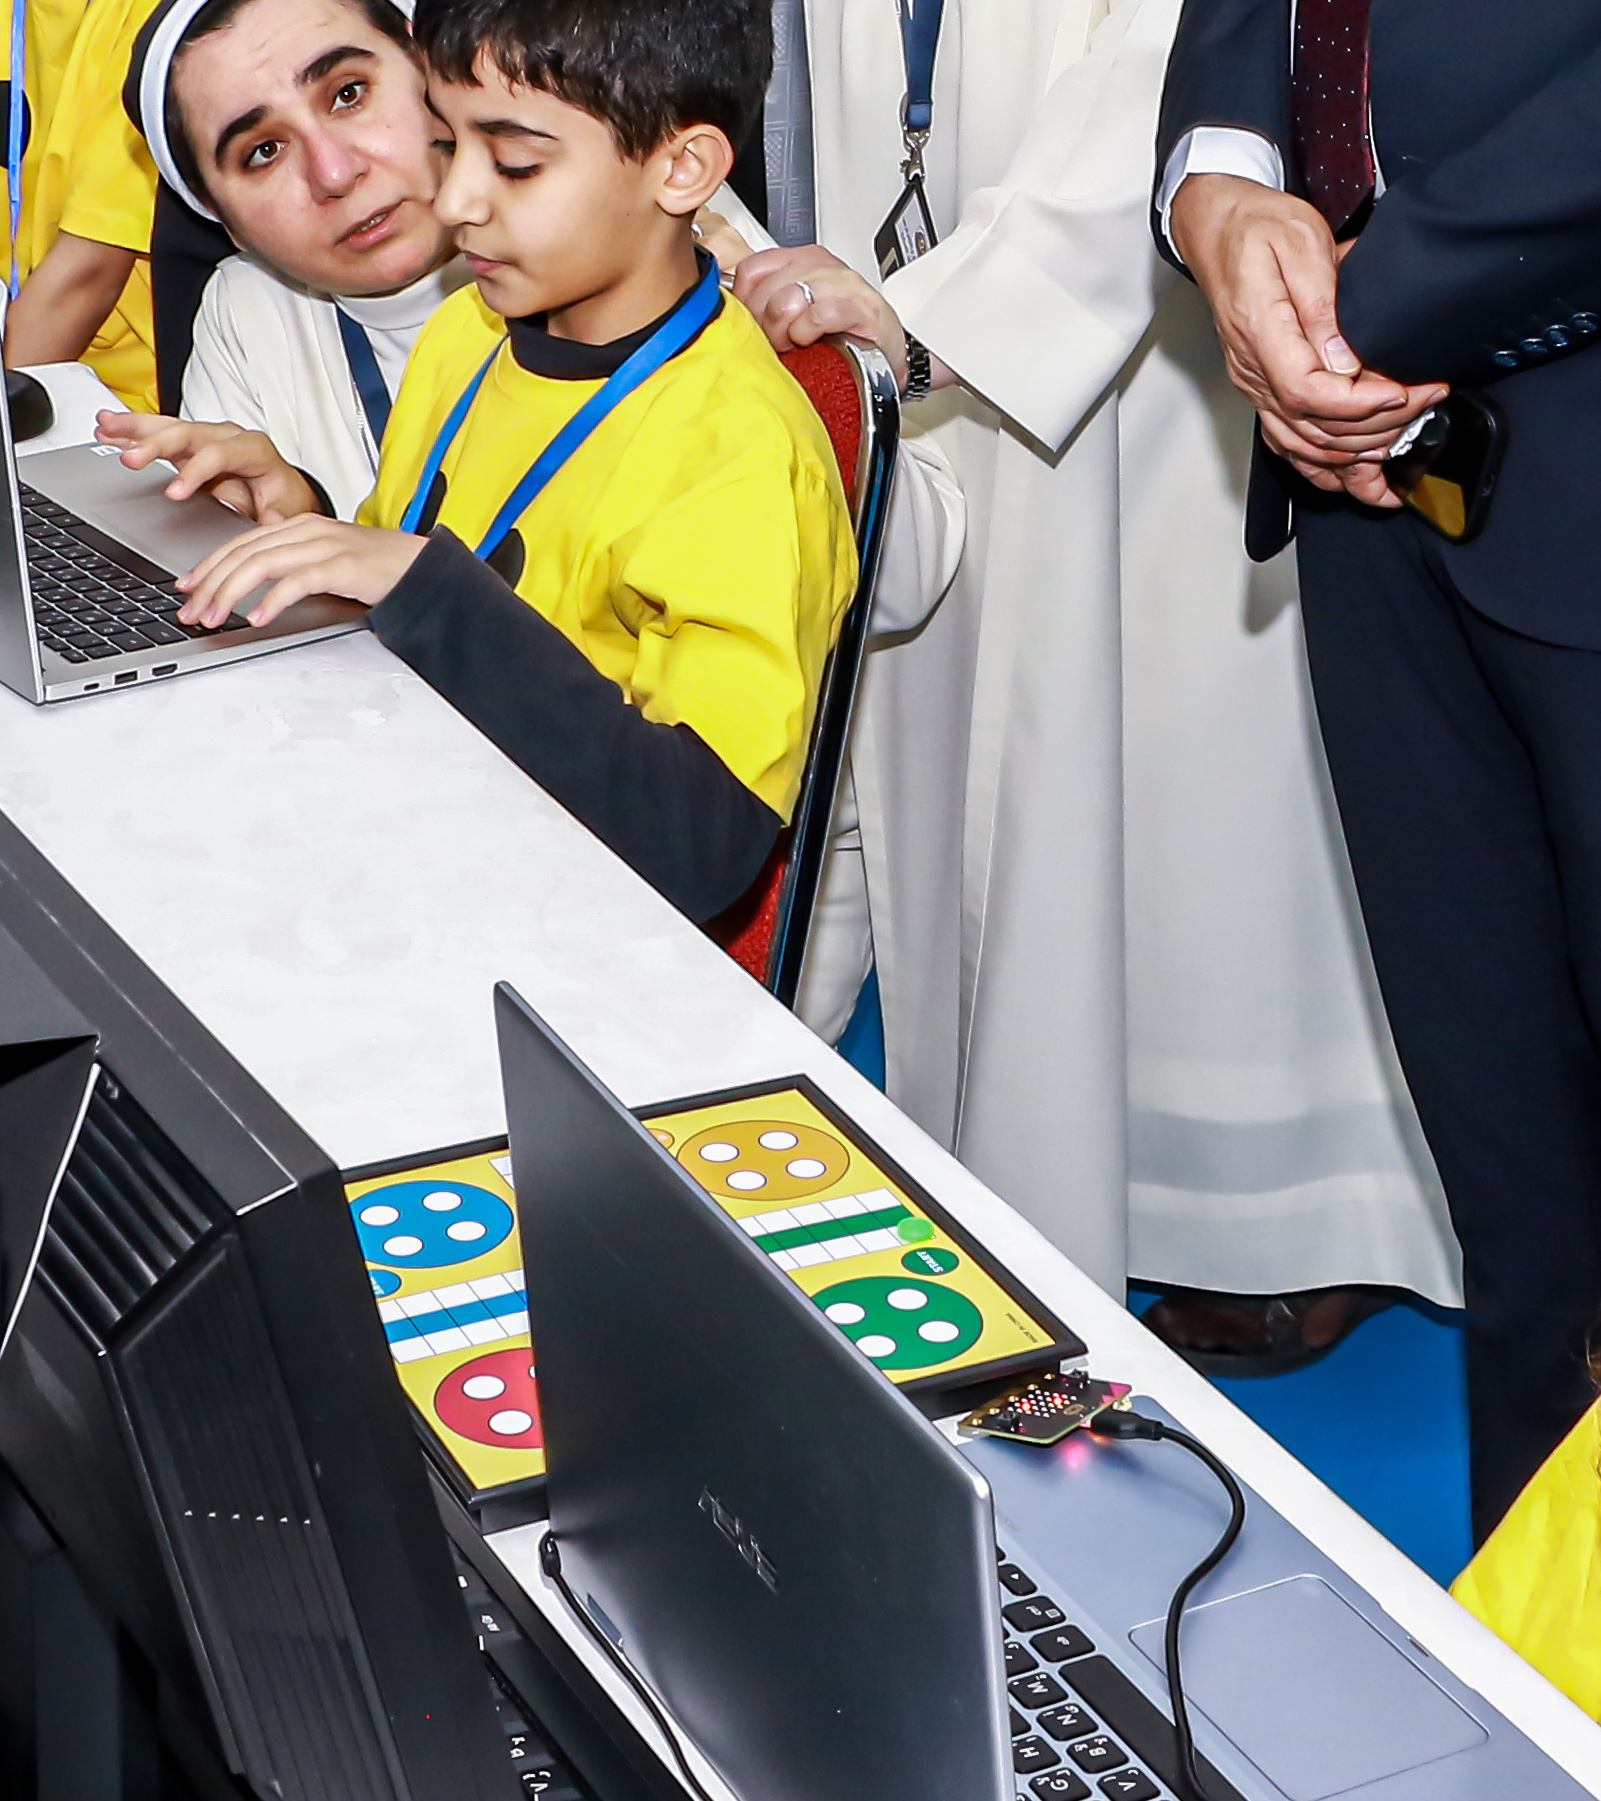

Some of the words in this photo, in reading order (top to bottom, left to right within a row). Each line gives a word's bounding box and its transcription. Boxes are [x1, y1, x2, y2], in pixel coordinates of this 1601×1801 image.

[916, 1251, 944, 1272] START
[1027, 1681, 1049, 1694] M
[1057, 1714, 1077, 1726] N
[1019, 1746, 1040, 1758] H
[1089, 1747, 1106, 1756] B
[1050, 1779, 1068, 1790] G
[1118, 1781, 1136, 1792] V
